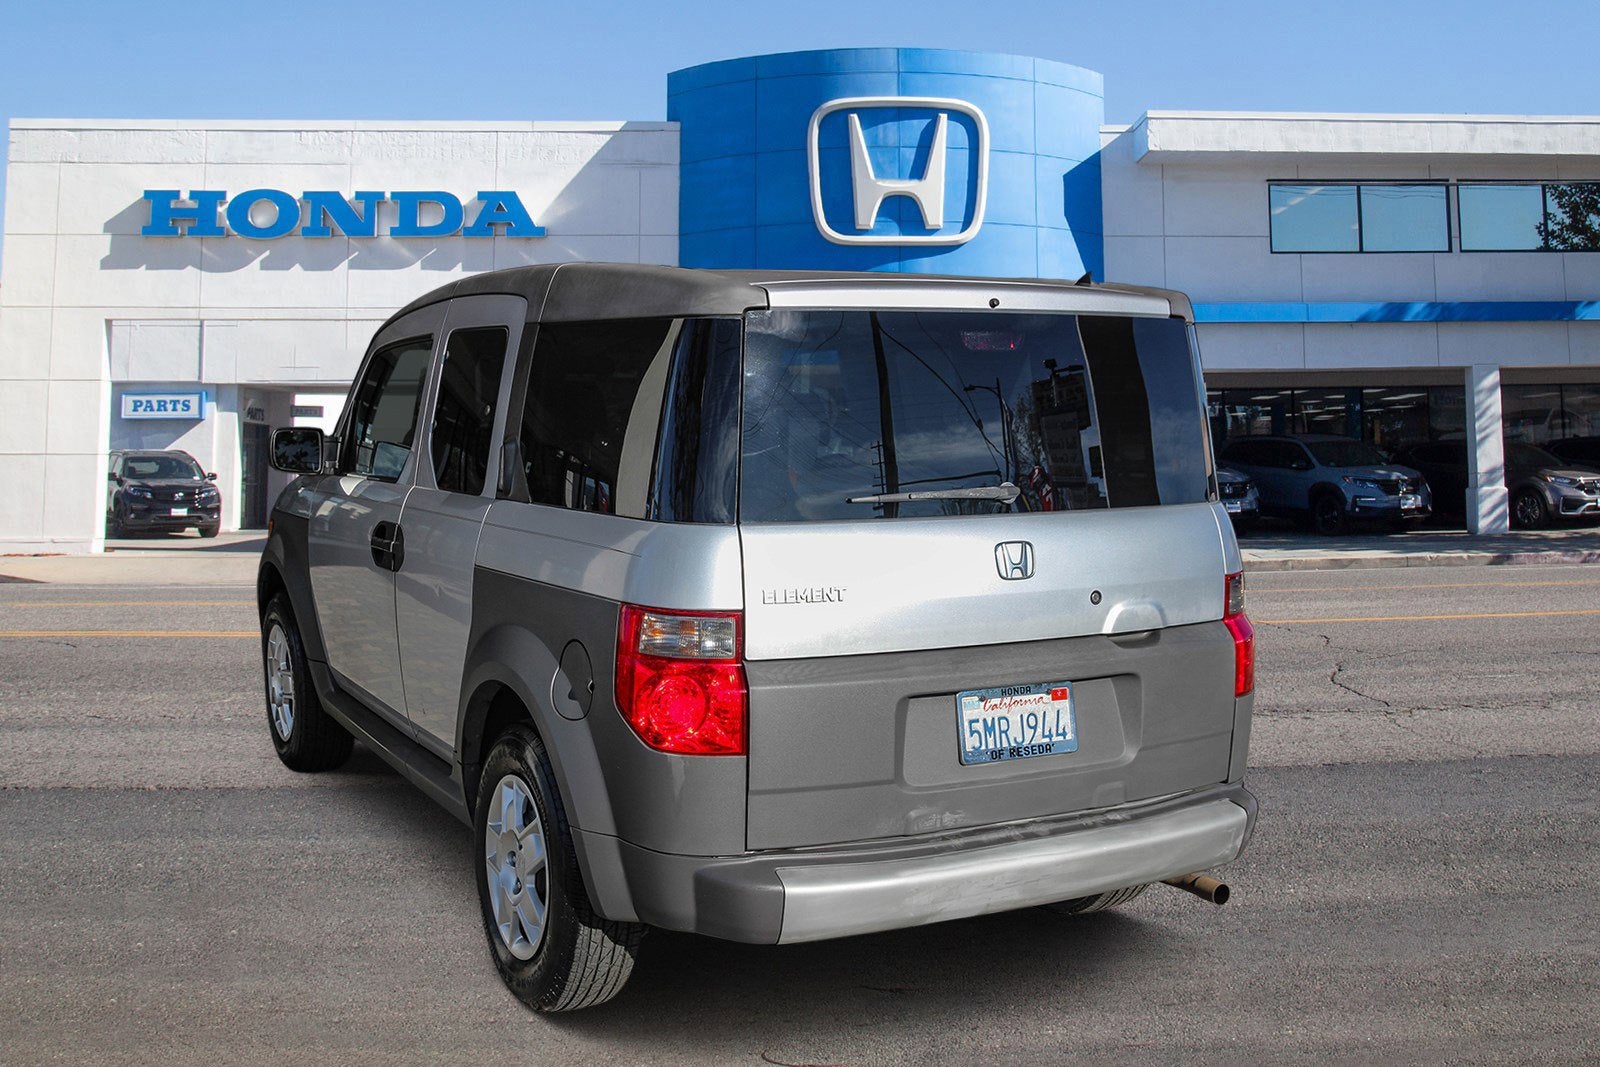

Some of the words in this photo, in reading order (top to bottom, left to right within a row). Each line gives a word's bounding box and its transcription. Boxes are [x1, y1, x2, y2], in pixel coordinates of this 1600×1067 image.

[141, 189, 547, 240] HONDA
[132, 400, 191, 412] PARTS
[762, 586, 847, 605] ELEMENT
[1001, 686, 1032, 696] HONDA
[983, 695, 1050, 714] California
[968, 709, 1068, 751] 5MRJ944
